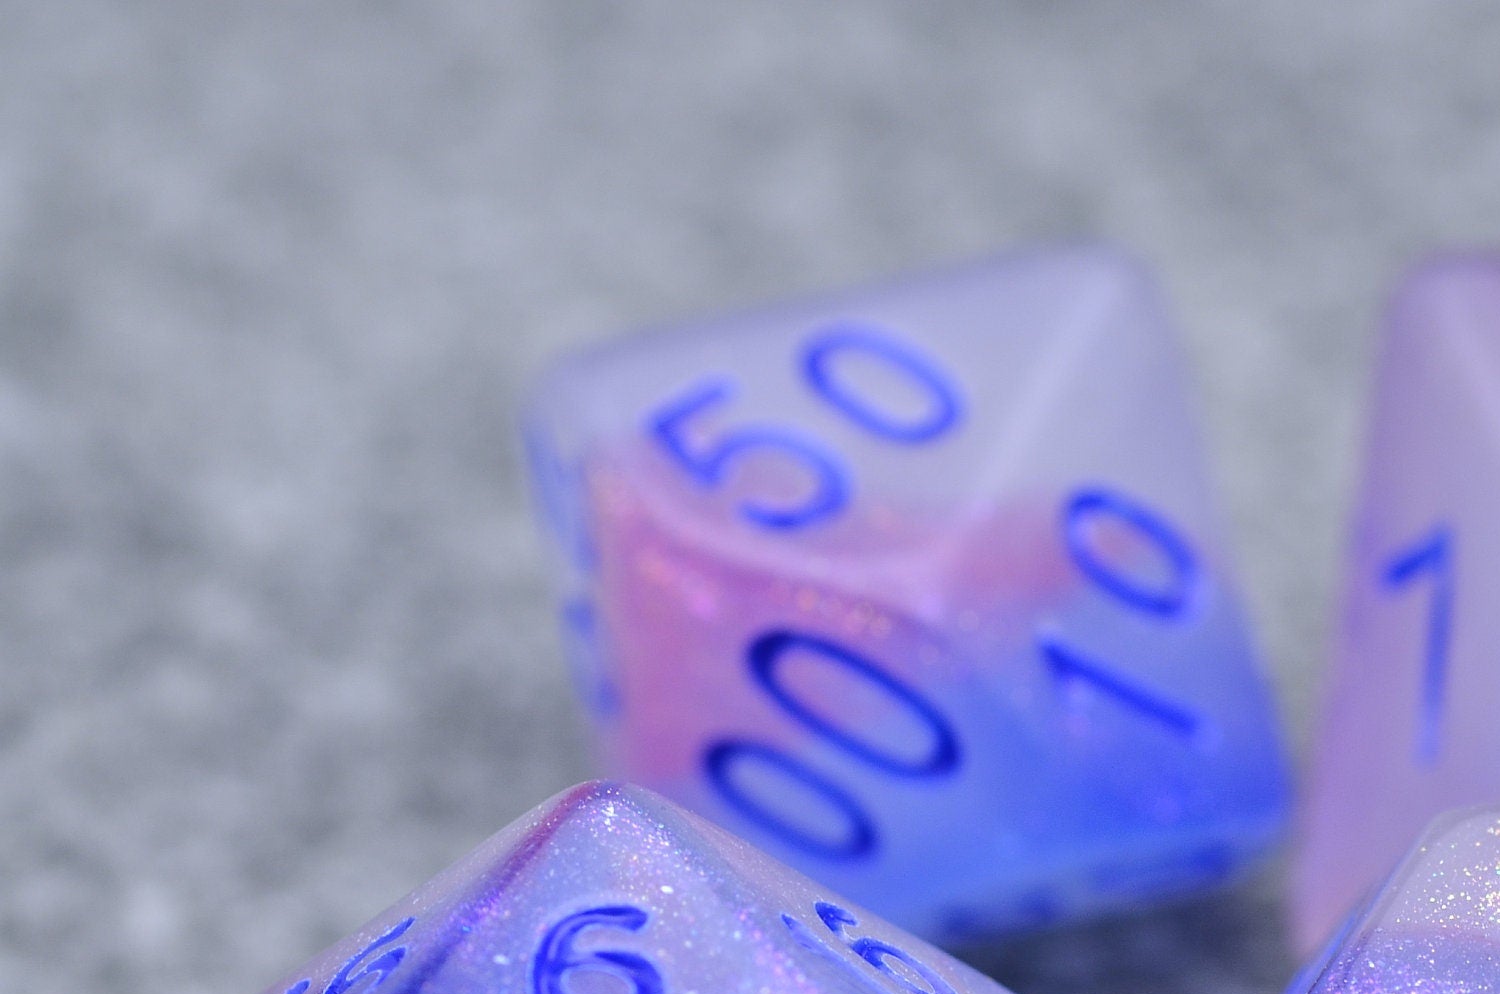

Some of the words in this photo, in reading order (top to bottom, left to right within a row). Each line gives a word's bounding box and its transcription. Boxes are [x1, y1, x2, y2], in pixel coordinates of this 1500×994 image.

[645, 320, 970, 534] 50
[1038, 482, 1202, 742] 10
[698, 627, 966, 866] 00
